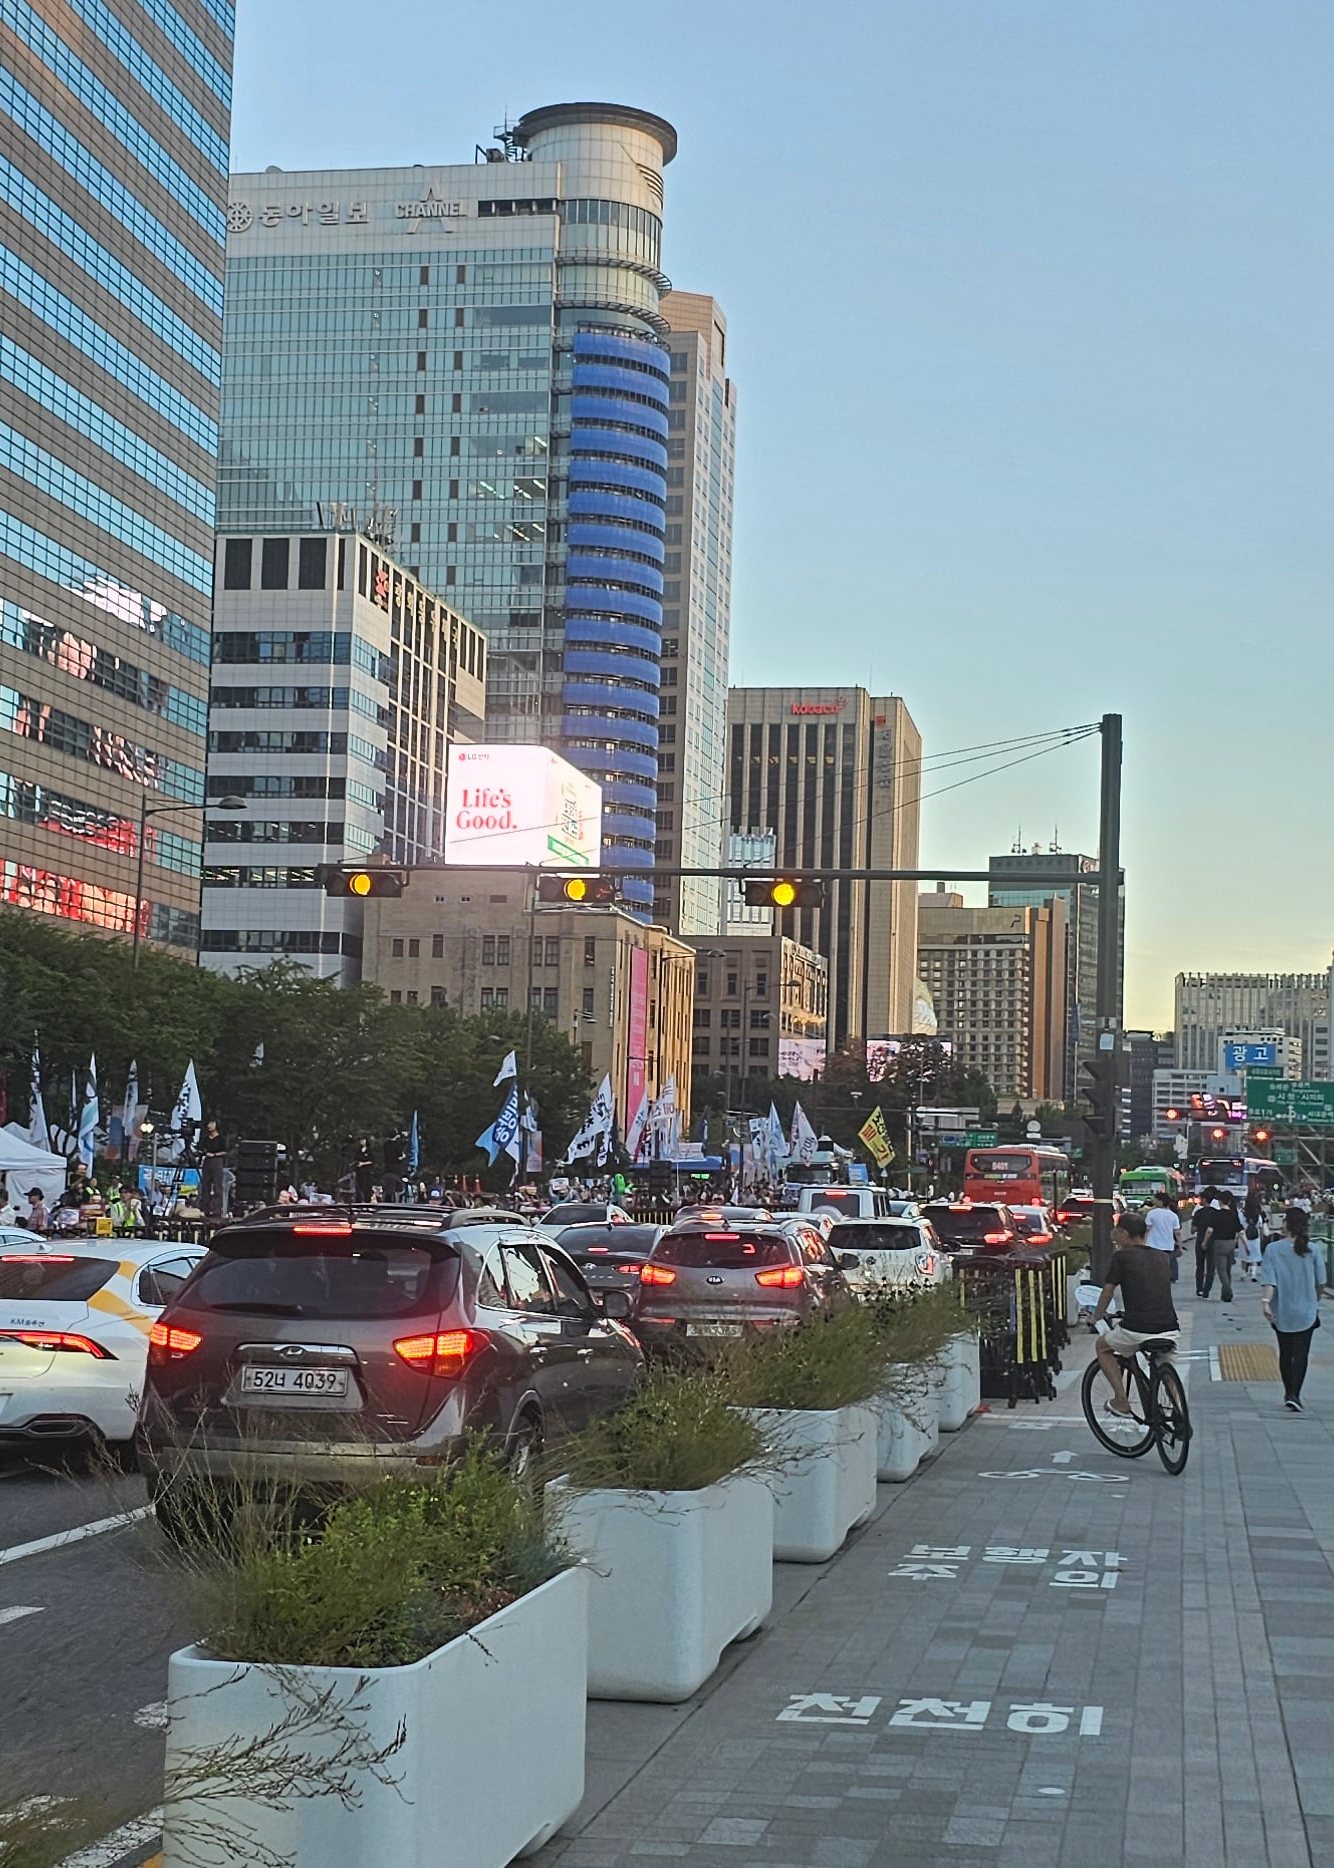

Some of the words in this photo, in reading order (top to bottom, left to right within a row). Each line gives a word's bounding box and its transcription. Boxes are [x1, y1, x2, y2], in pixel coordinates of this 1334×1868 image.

[259, 200, 370, 228] 동아일보
[394, 200, 468, 218] CHANNEL
[467, 753, 477, 761] LG
[462, 788, 512, 809] Life's
[456, 810, 518, 830] Good.
[1232, 1046, 1269, 1062] 광고
[253, 1371, 286, 1387] 52너
[293, 1373, 337, 1390] 4039
[902, 1544, 1129, 1567] 보행자
[774, 1692, 1104, 1736] 천천히
